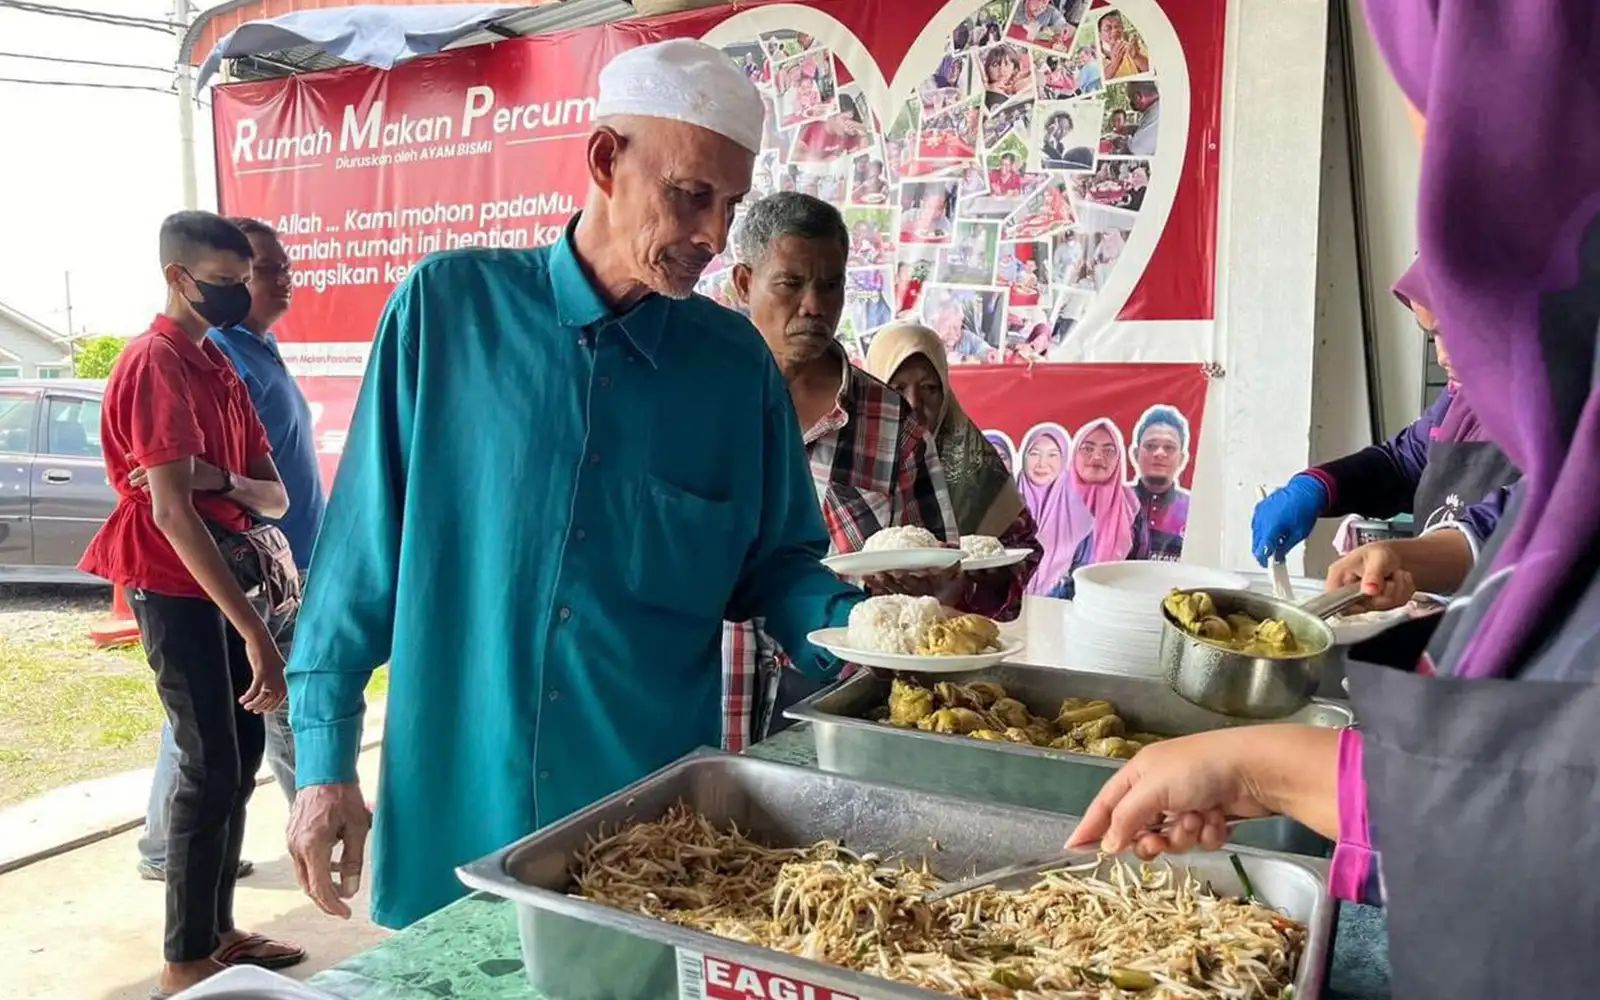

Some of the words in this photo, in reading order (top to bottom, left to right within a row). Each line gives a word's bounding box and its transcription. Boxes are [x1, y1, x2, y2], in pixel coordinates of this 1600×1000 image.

[232, 118, 333, 163] Rumah
[339, 100, 453, 152] Makan
[461, 85, 598, 138] Percum
[335, 154, 392, 170] Diuruskan
[394, 149, 418, 163] oleh
[420, 144, 456, 160] AYAM
[456, 140, 493, 156] BISMI
[276, 212, 322, 234] Allah
[344, 204, 398, 232] Kami
[401, 201, 474, 227] mohon
[346, 233, 414, 258] rumah
[417, 228, 441, 253] ini
[445, 224, 528, 250] hentian
[288, 262, 379, 294] ongsikan
[706, 958, 858, 1000] EAGL
